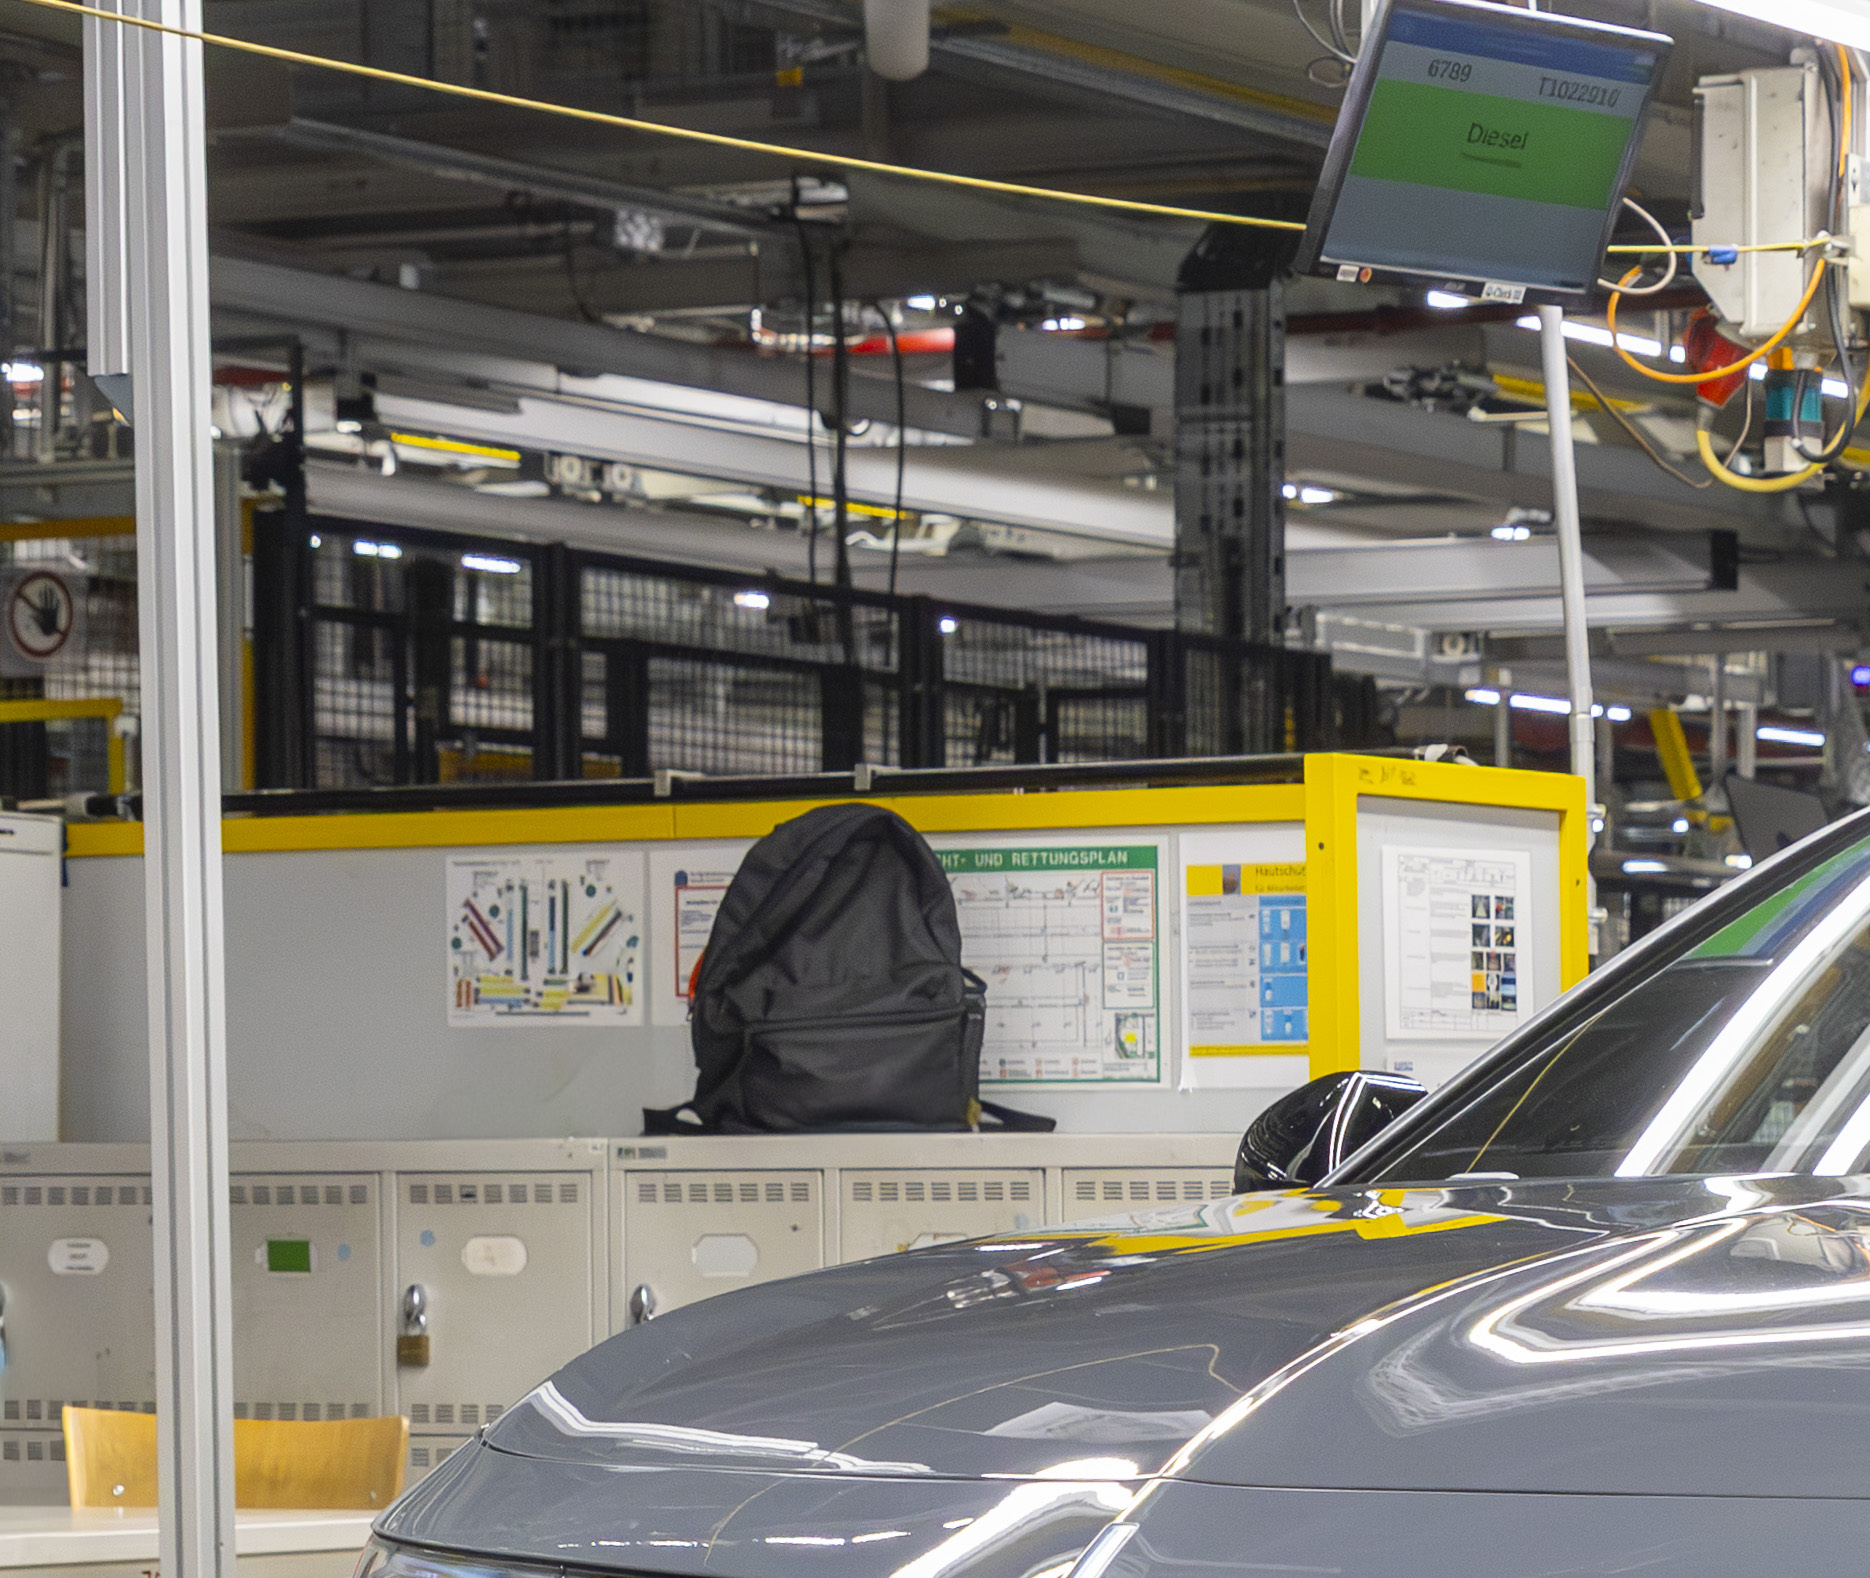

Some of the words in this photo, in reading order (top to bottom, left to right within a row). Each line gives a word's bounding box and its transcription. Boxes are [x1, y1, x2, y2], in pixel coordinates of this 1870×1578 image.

[1427, 59, 1472, 82] 6789
[1466, 122, 1529, 150] Diesel
[975, 853, 1003, 868] UND
[1012, 850, 1128, 867] RETTUNGSPLAN
